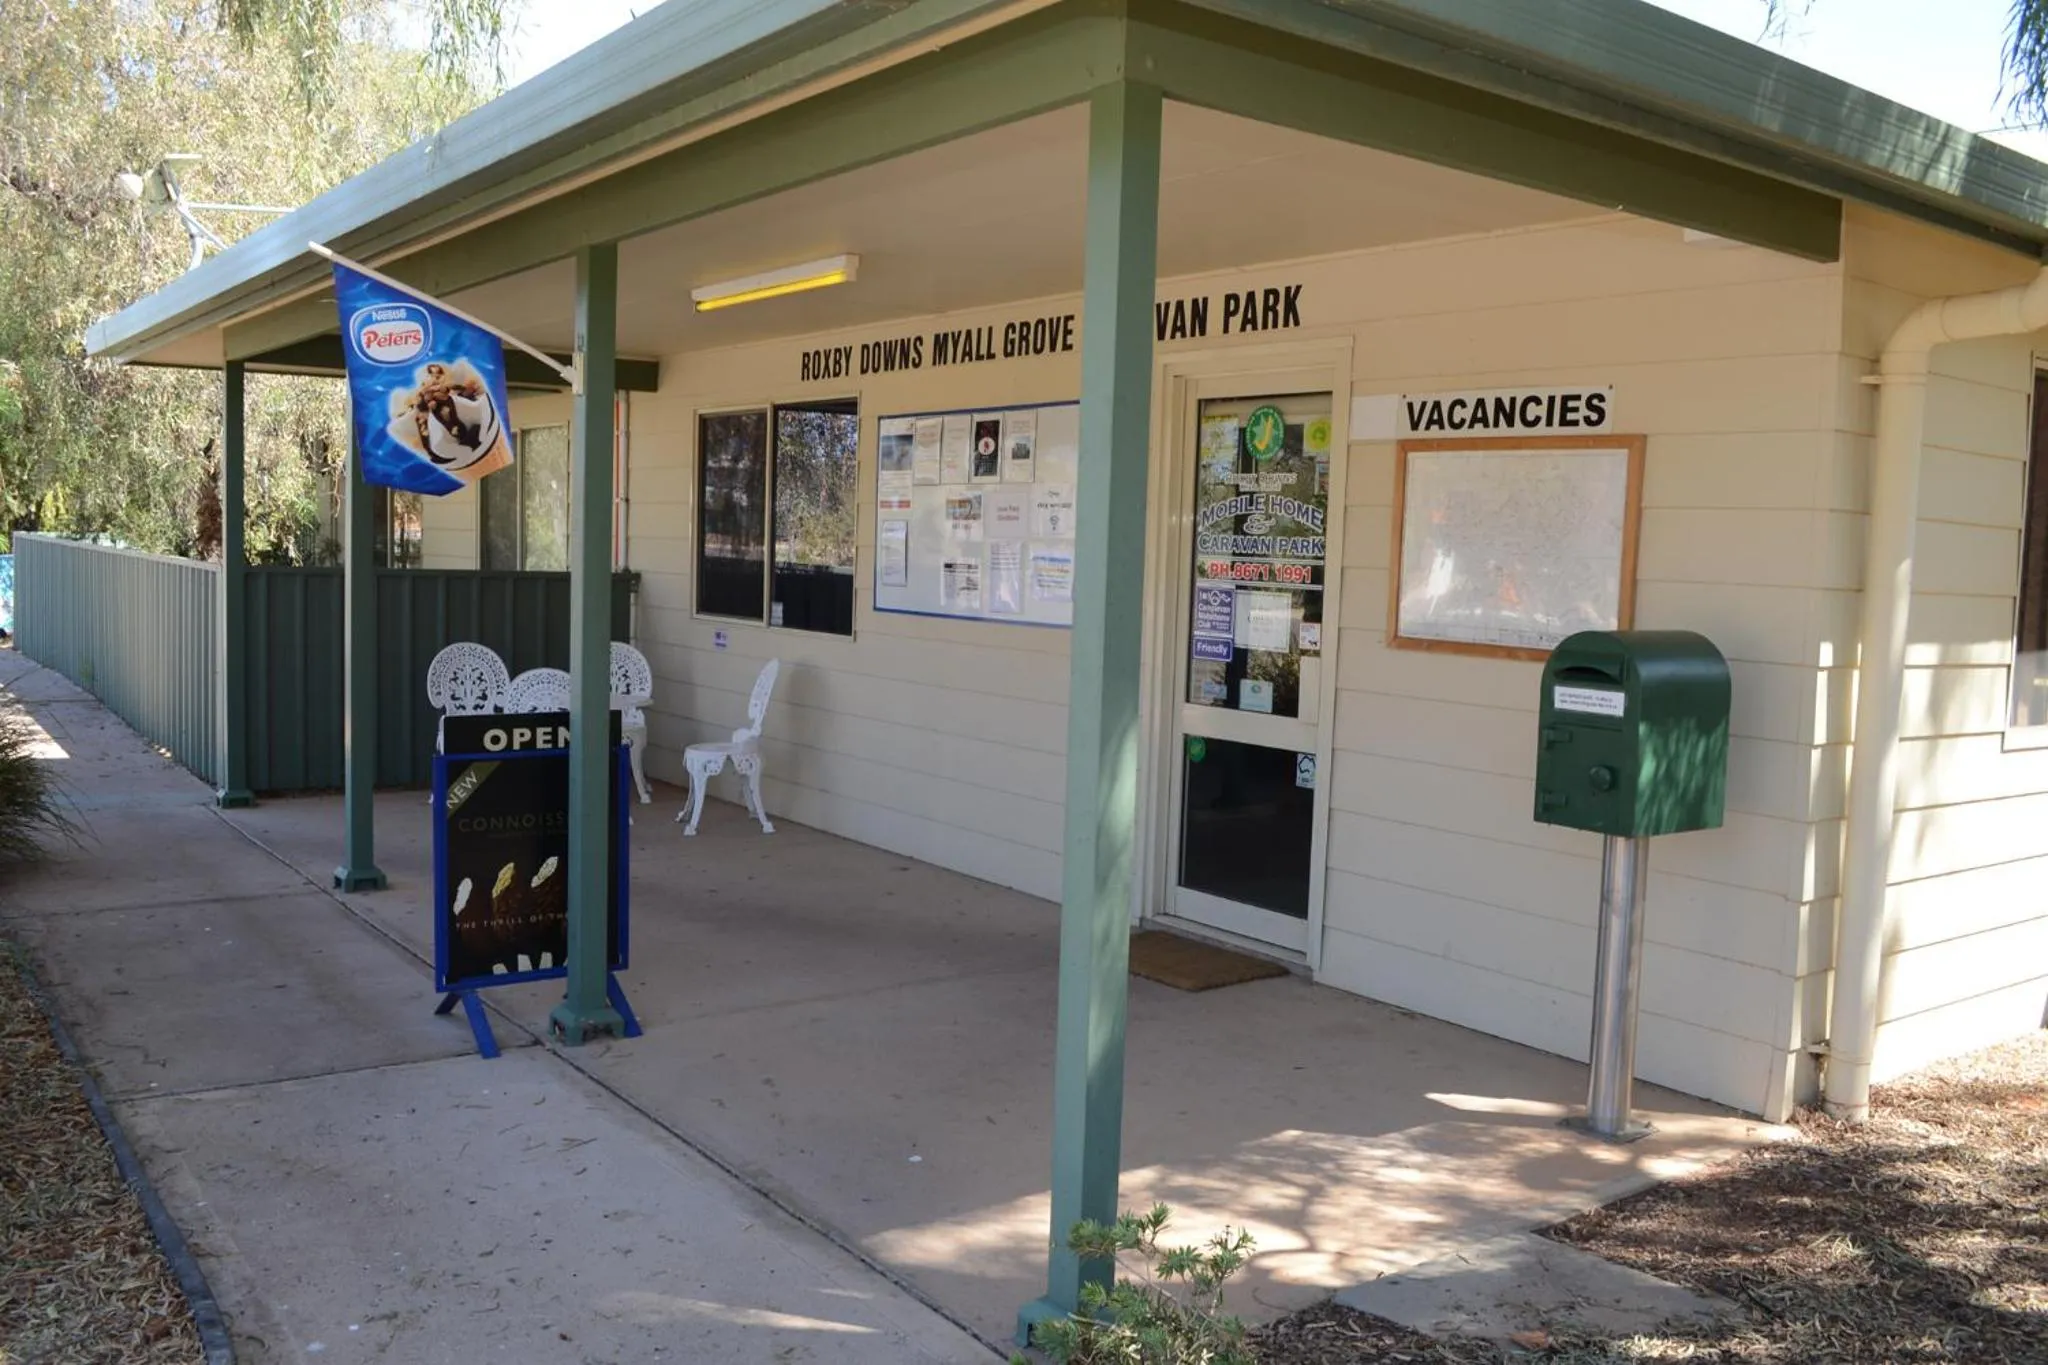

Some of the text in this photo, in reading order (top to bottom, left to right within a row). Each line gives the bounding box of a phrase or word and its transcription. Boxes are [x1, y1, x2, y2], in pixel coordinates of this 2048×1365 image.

[363, 328, 422, 349] Peters
[800, 344, 852, 382] ROXBY
[859, 335, 924, 375] DOWNS
[931, 324, 997, 367] MYALL
[1002, 314, 1075, 358] GROVE
[1222, 284, 1303, 335] PARK
[1407, 393, 1607, 431] VACANCIES
[1201, 493, 1324, 534] MOBILE HOME
[1243, 513, 1276, 535] &
[1199, 534, 1324, 556] CARAVAN PARK
[1274, 562, 1312, 584] 1991
[1196, 642, 1229, 658] Friendly
[446, 771, 478, 808] NEW
[458, 810, 566, 834] CONNOISS
